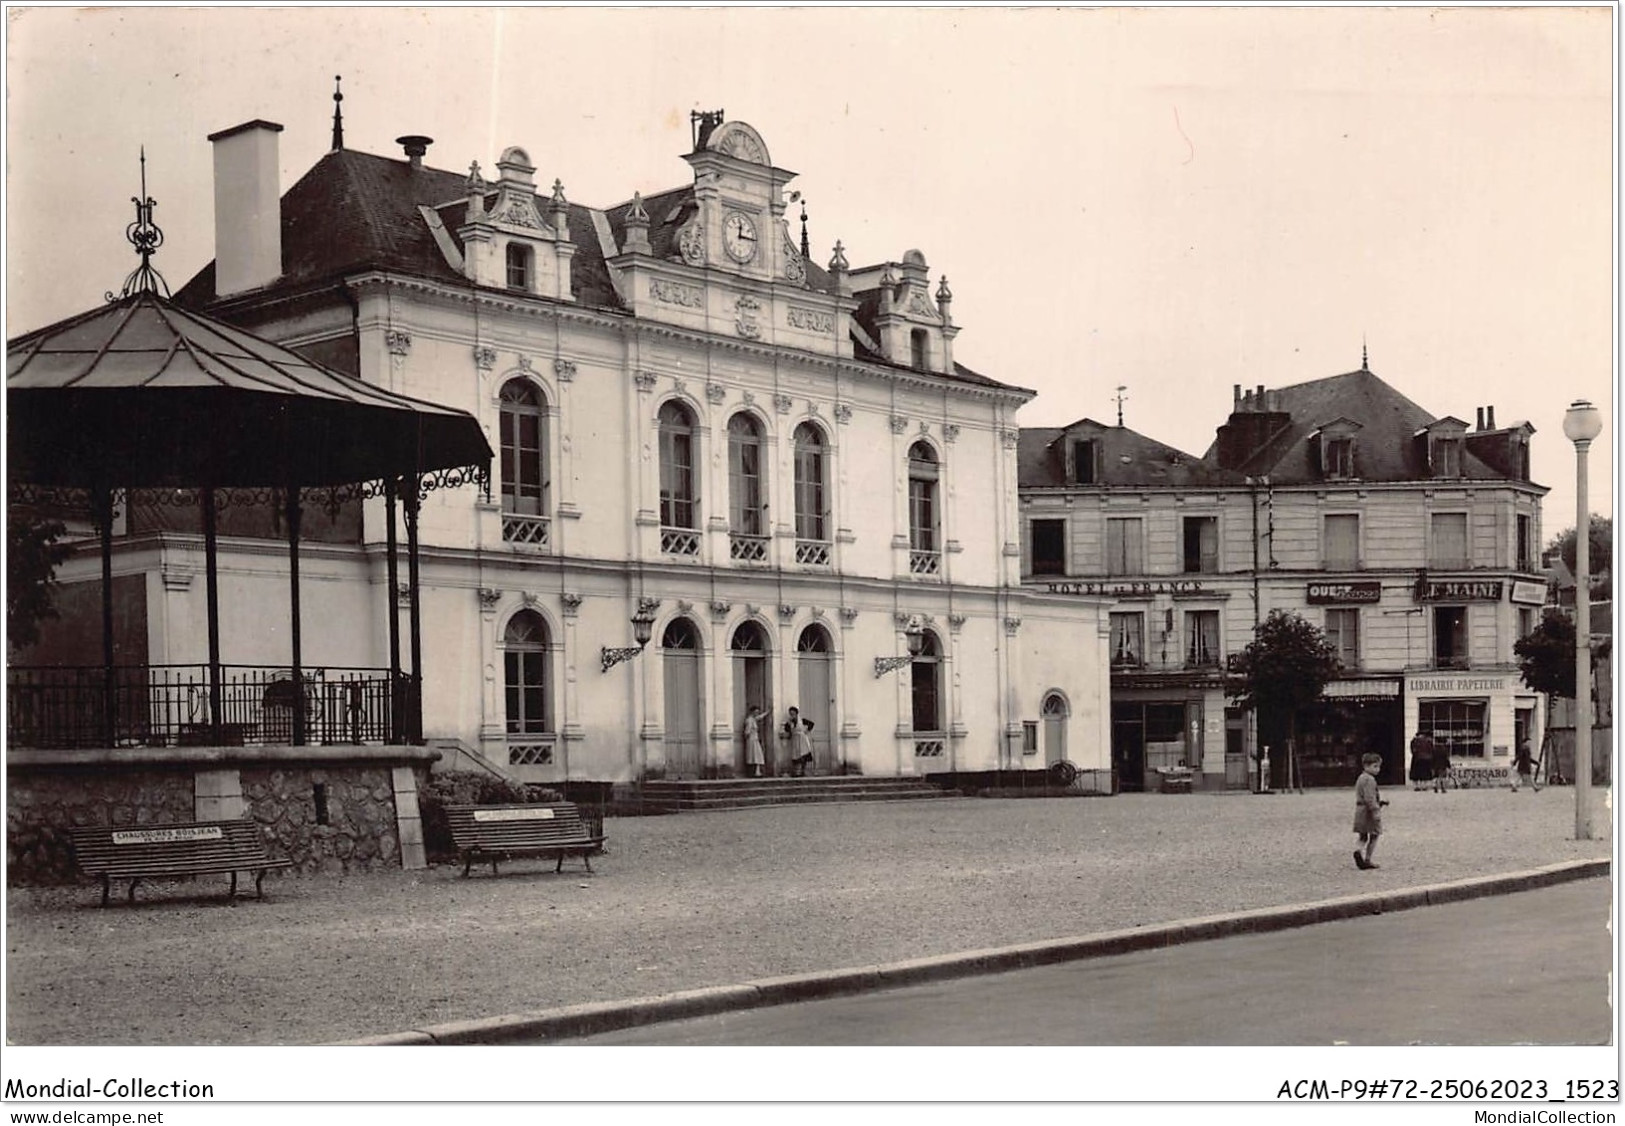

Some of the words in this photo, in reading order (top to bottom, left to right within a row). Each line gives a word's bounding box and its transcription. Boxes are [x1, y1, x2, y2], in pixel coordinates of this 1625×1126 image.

[1132, 582, 1202, 594] FRANCE
[1445, 583, 1497, 598] MAINE
[1410, 680, 1454, 691] LIBRAIRIE
[1457, 679, 1505, 690] PAPETERIE
[116, 830, 173, 841] CHAUSSURES
